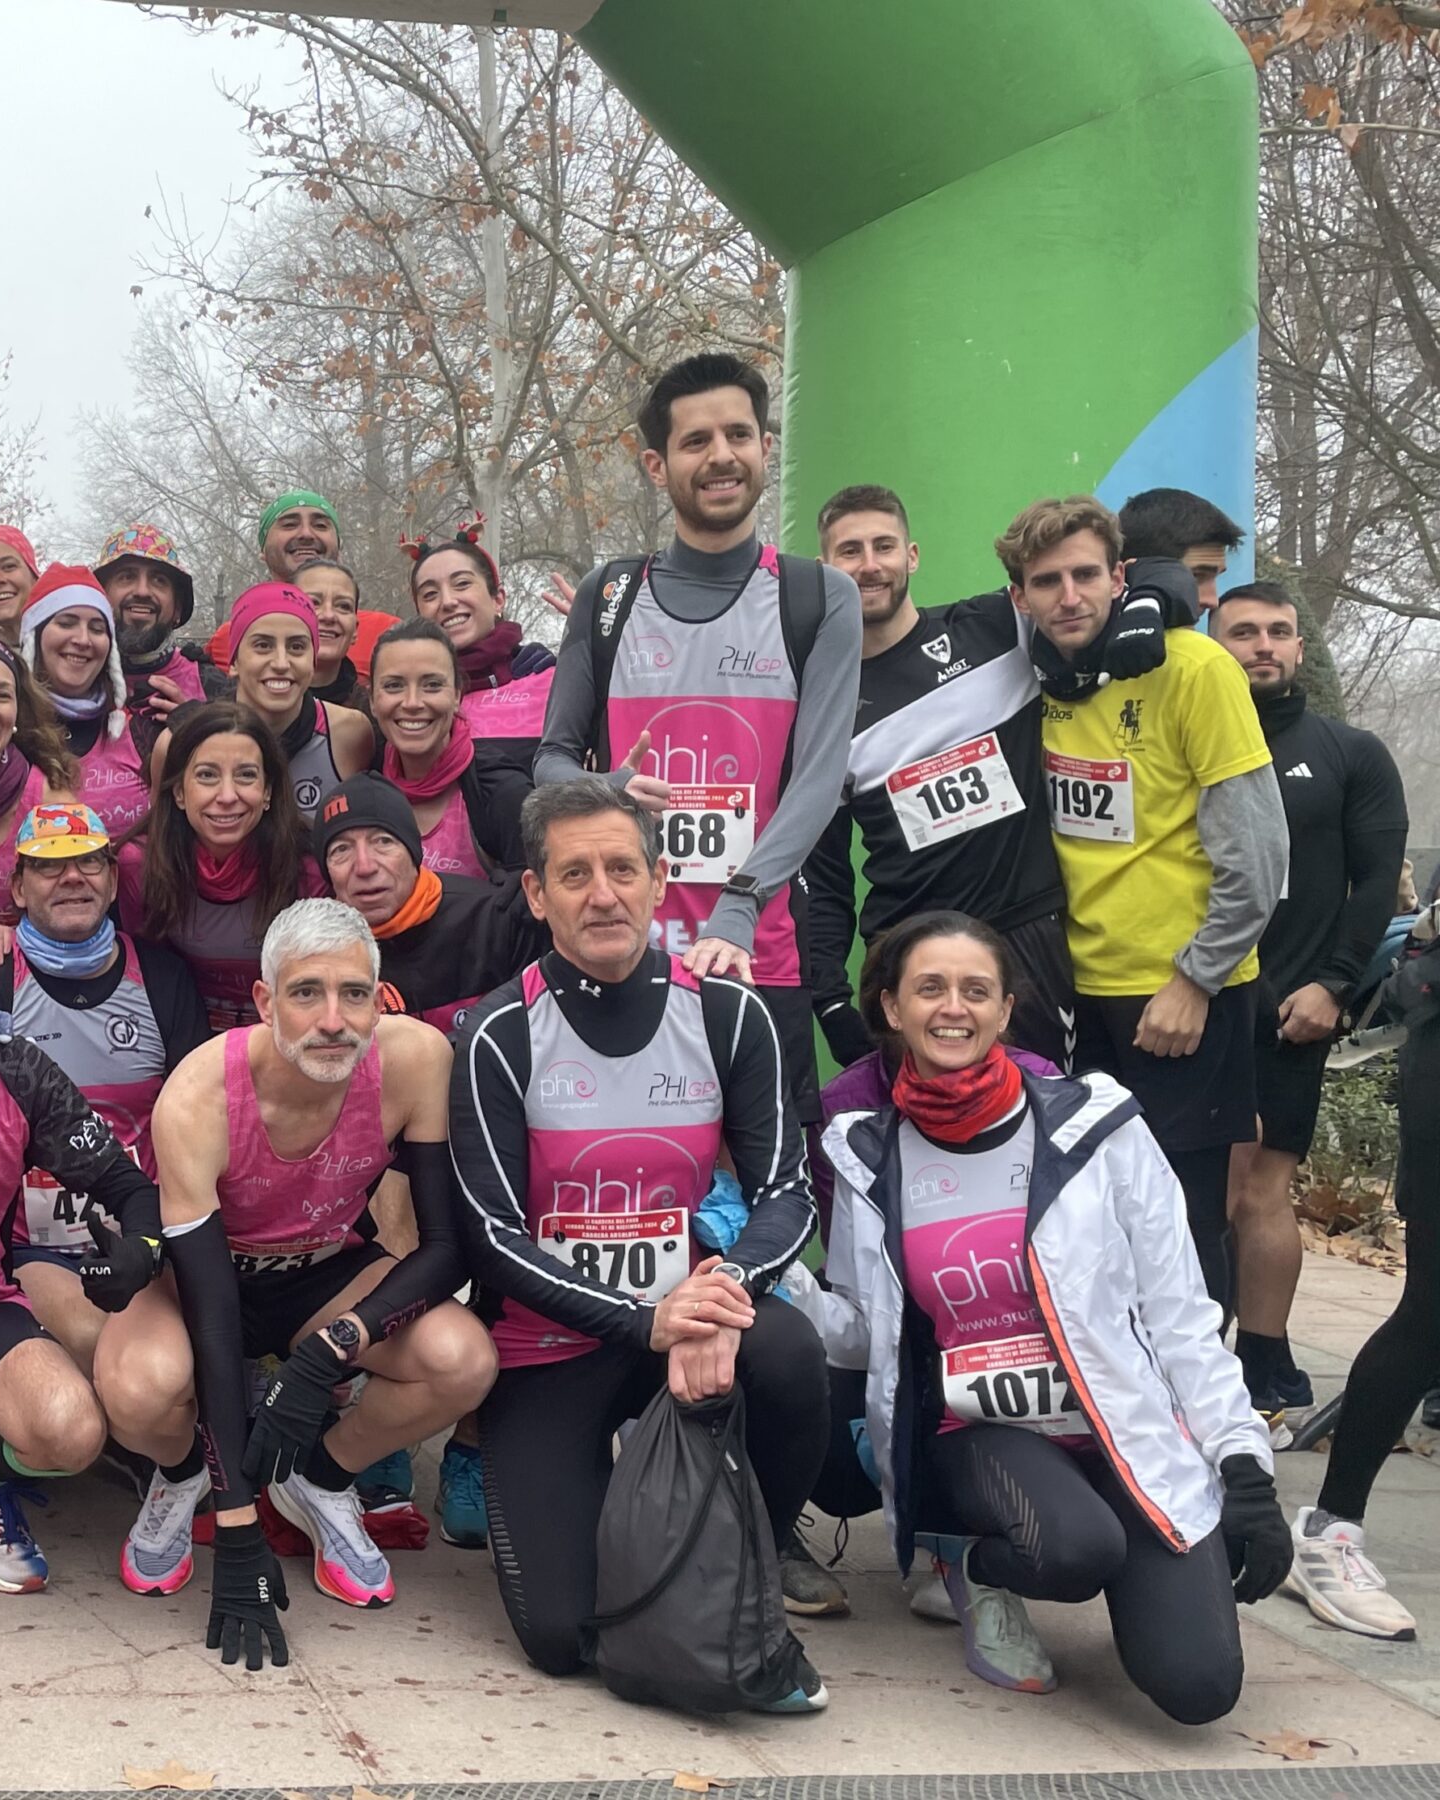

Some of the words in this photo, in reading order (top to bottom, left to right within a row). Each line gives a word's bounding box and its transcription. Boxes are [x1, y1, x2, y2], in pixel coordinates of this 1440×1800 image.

[601, 572, 631, 637] ellesse
[945, 658, 967, 674] HGT
[915, 765, 990, 821] 163
[1049, 775, 1114, 821] 1192
[89, 1266, 111, 1275] run
[571, 1241, 656, 1289] 870
